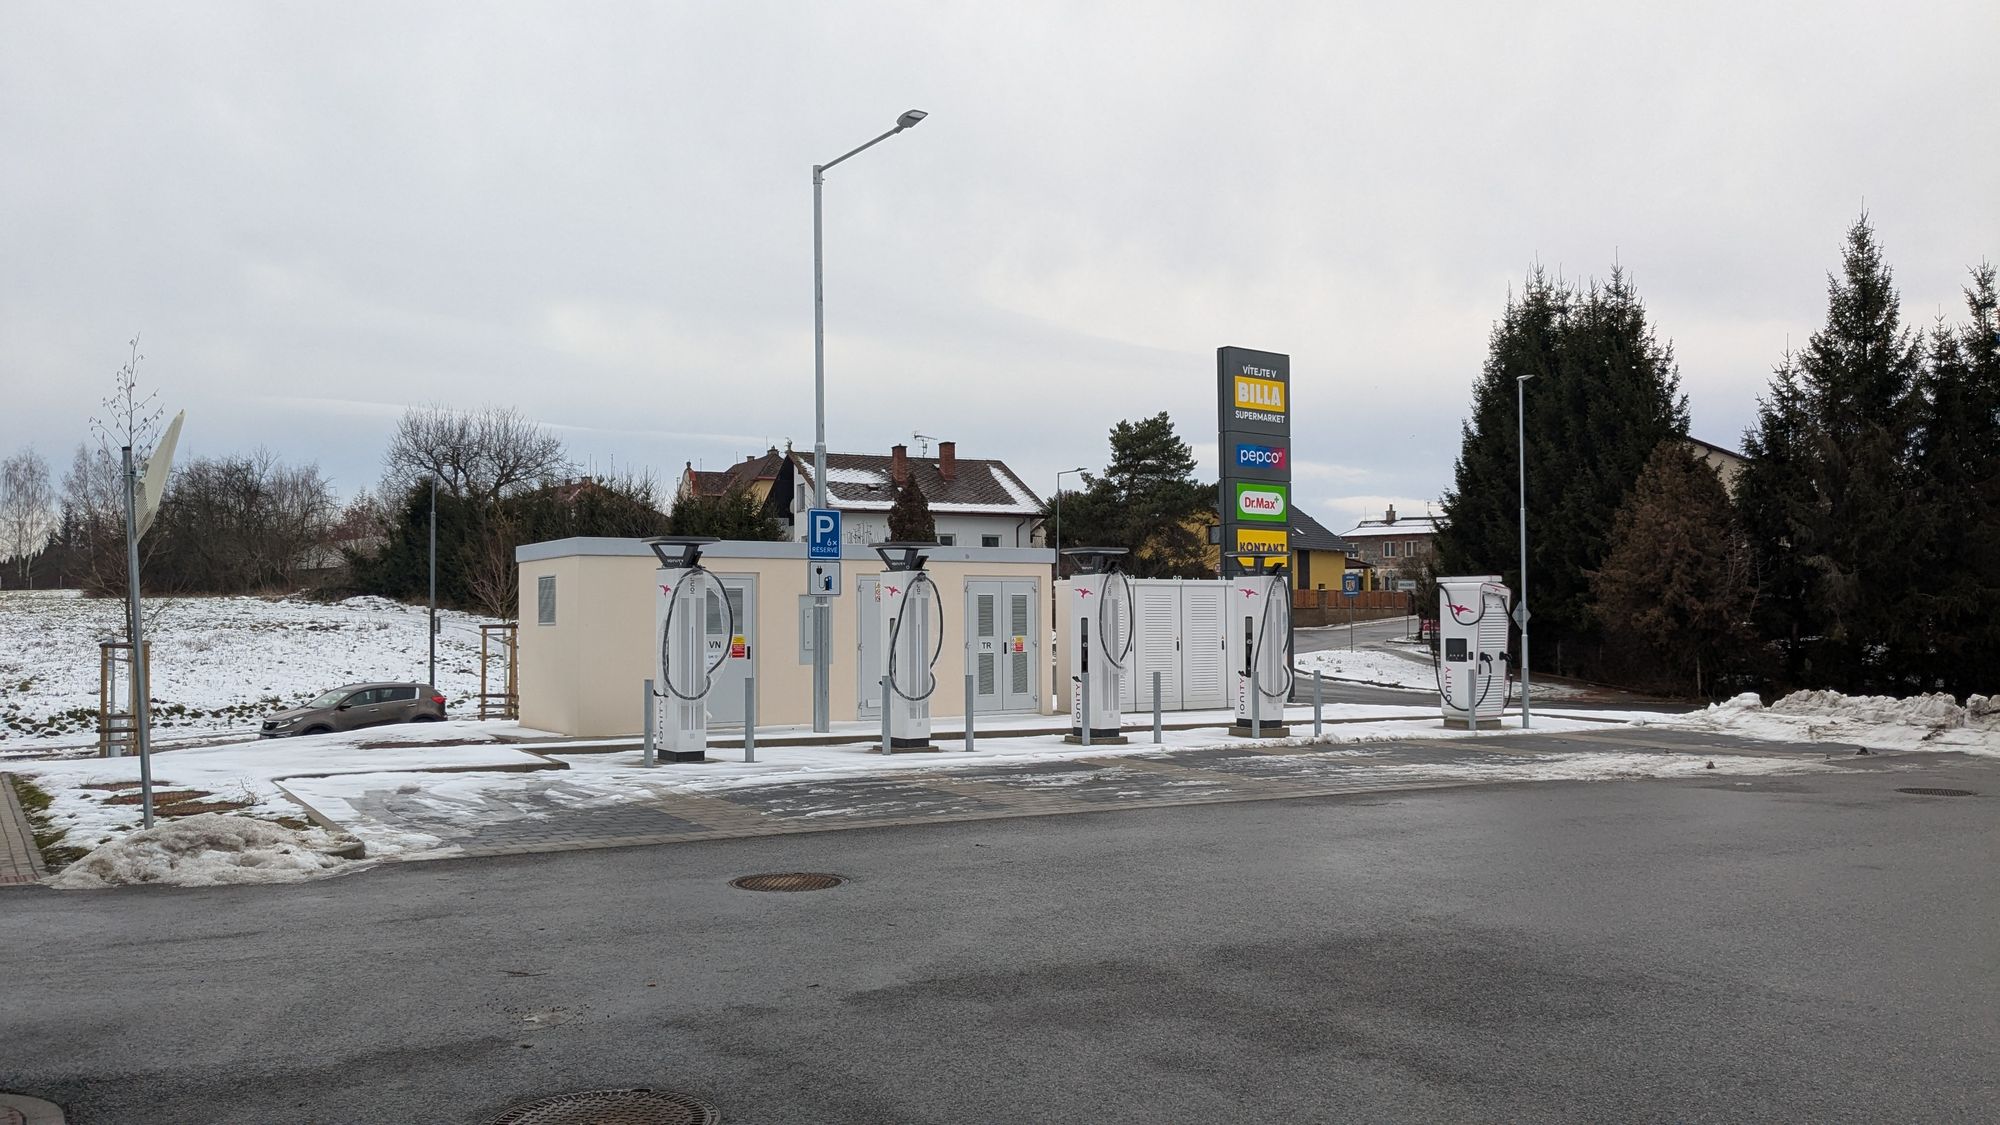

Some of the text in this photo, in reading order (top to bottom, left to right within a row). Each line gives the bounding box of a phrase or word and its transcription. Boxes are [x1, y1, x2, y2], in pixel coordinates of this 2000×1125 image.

[1271, 370, 1277, 379] V
[1237, 381, 1281, 407] BILLA
[1235, 410, 1285, 424] SUPERMARKET
[815, 515, 834, 544] P
[1240, 541, 1285, 552] KONTAKT
[709, 640, 721, 649] VN
[982, 641, 992, 649] TR
